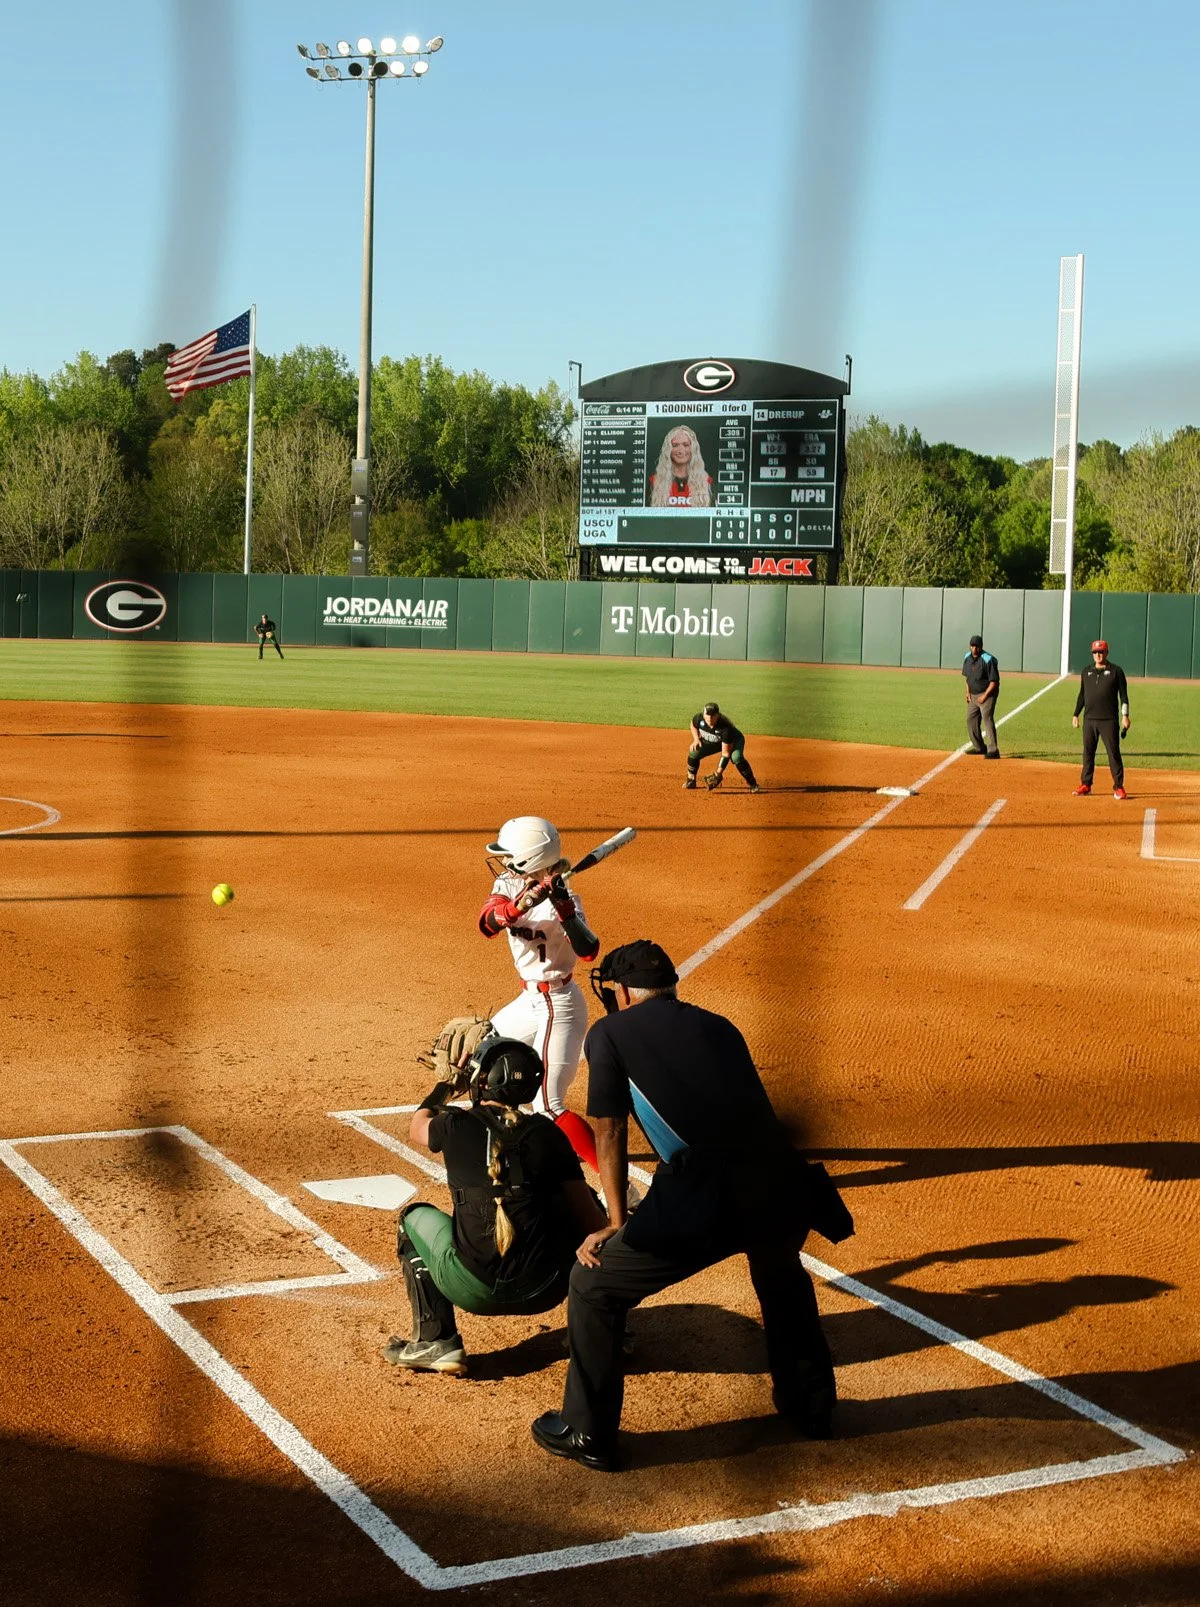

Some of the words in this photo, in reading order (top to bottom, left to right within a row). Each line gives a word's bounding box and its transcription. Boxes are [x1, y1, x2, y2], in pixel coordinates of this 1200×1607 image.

[656, 404, 659, 413] 1
[662, 404, 713, 413] GOODNIGHT
[769, 410, 804, 419] DRERUP
[791, 489, 826, 503] MPH
[769, 514, 776, 522] S
[784, 514, 792, 522] O
[756, 529, 760, 539] 1
[769, 529, 776, 539] 0
[785, 529, 792, 539] 0
[600, 556, 721, 574] WELCOME
[724, 558, 739, 566] TO
[724, 566, 746, 574] THE
[748, 557, 813, 576] JACK
[639, 606, 735, 636] Mobile
[537, 944, 546, 963] 1
